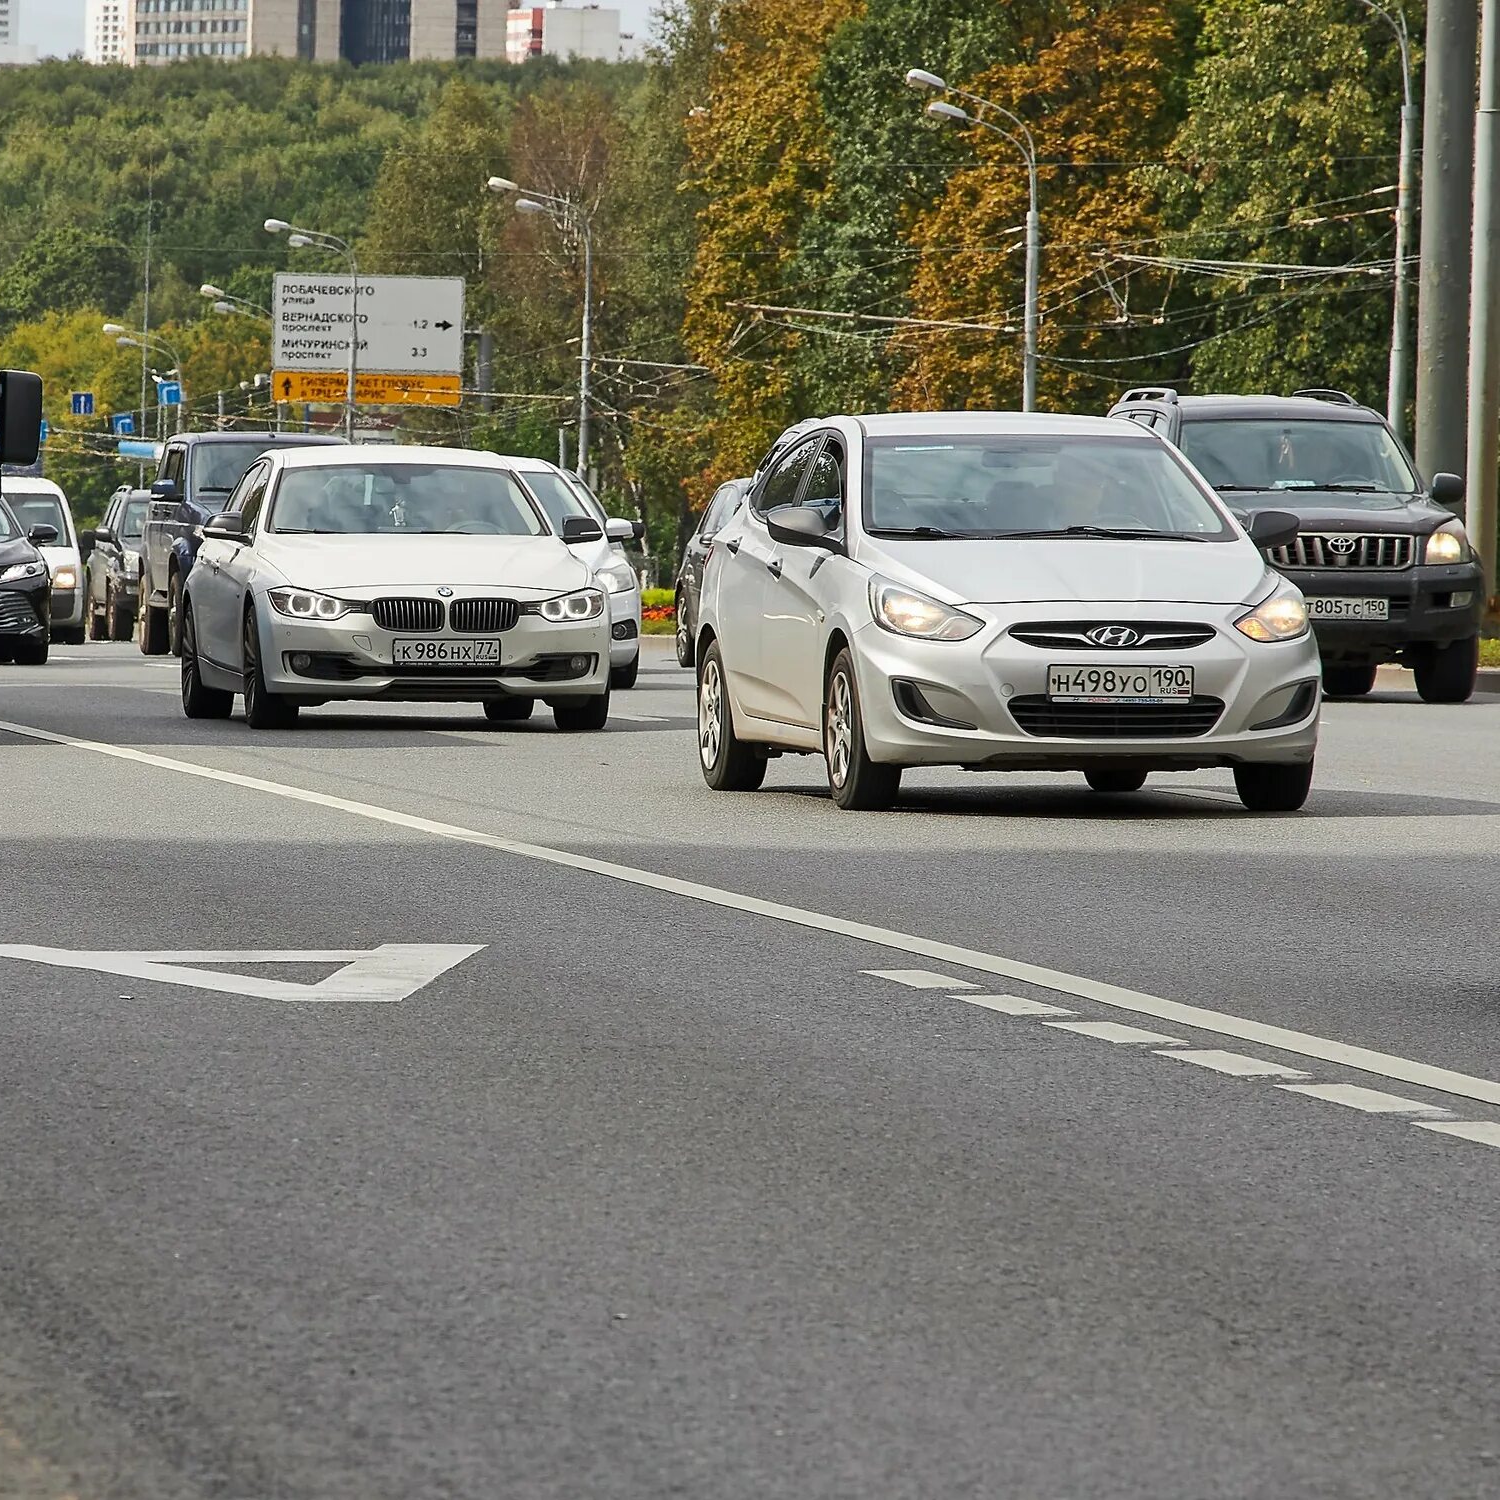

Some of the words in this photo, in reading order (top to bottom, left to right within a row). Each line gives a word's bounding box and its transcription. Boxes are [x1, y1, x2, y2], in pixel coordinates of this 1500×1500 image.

[282, 324, 332, 333] проспект
[281, 351, 332, 360] проспект
[1364, 600, 1385, 612] 150
[476, 642, 493, 655] 77
[1152, 669, 1186, 687] 190
[1160, 687, 1178, 695] RUS
